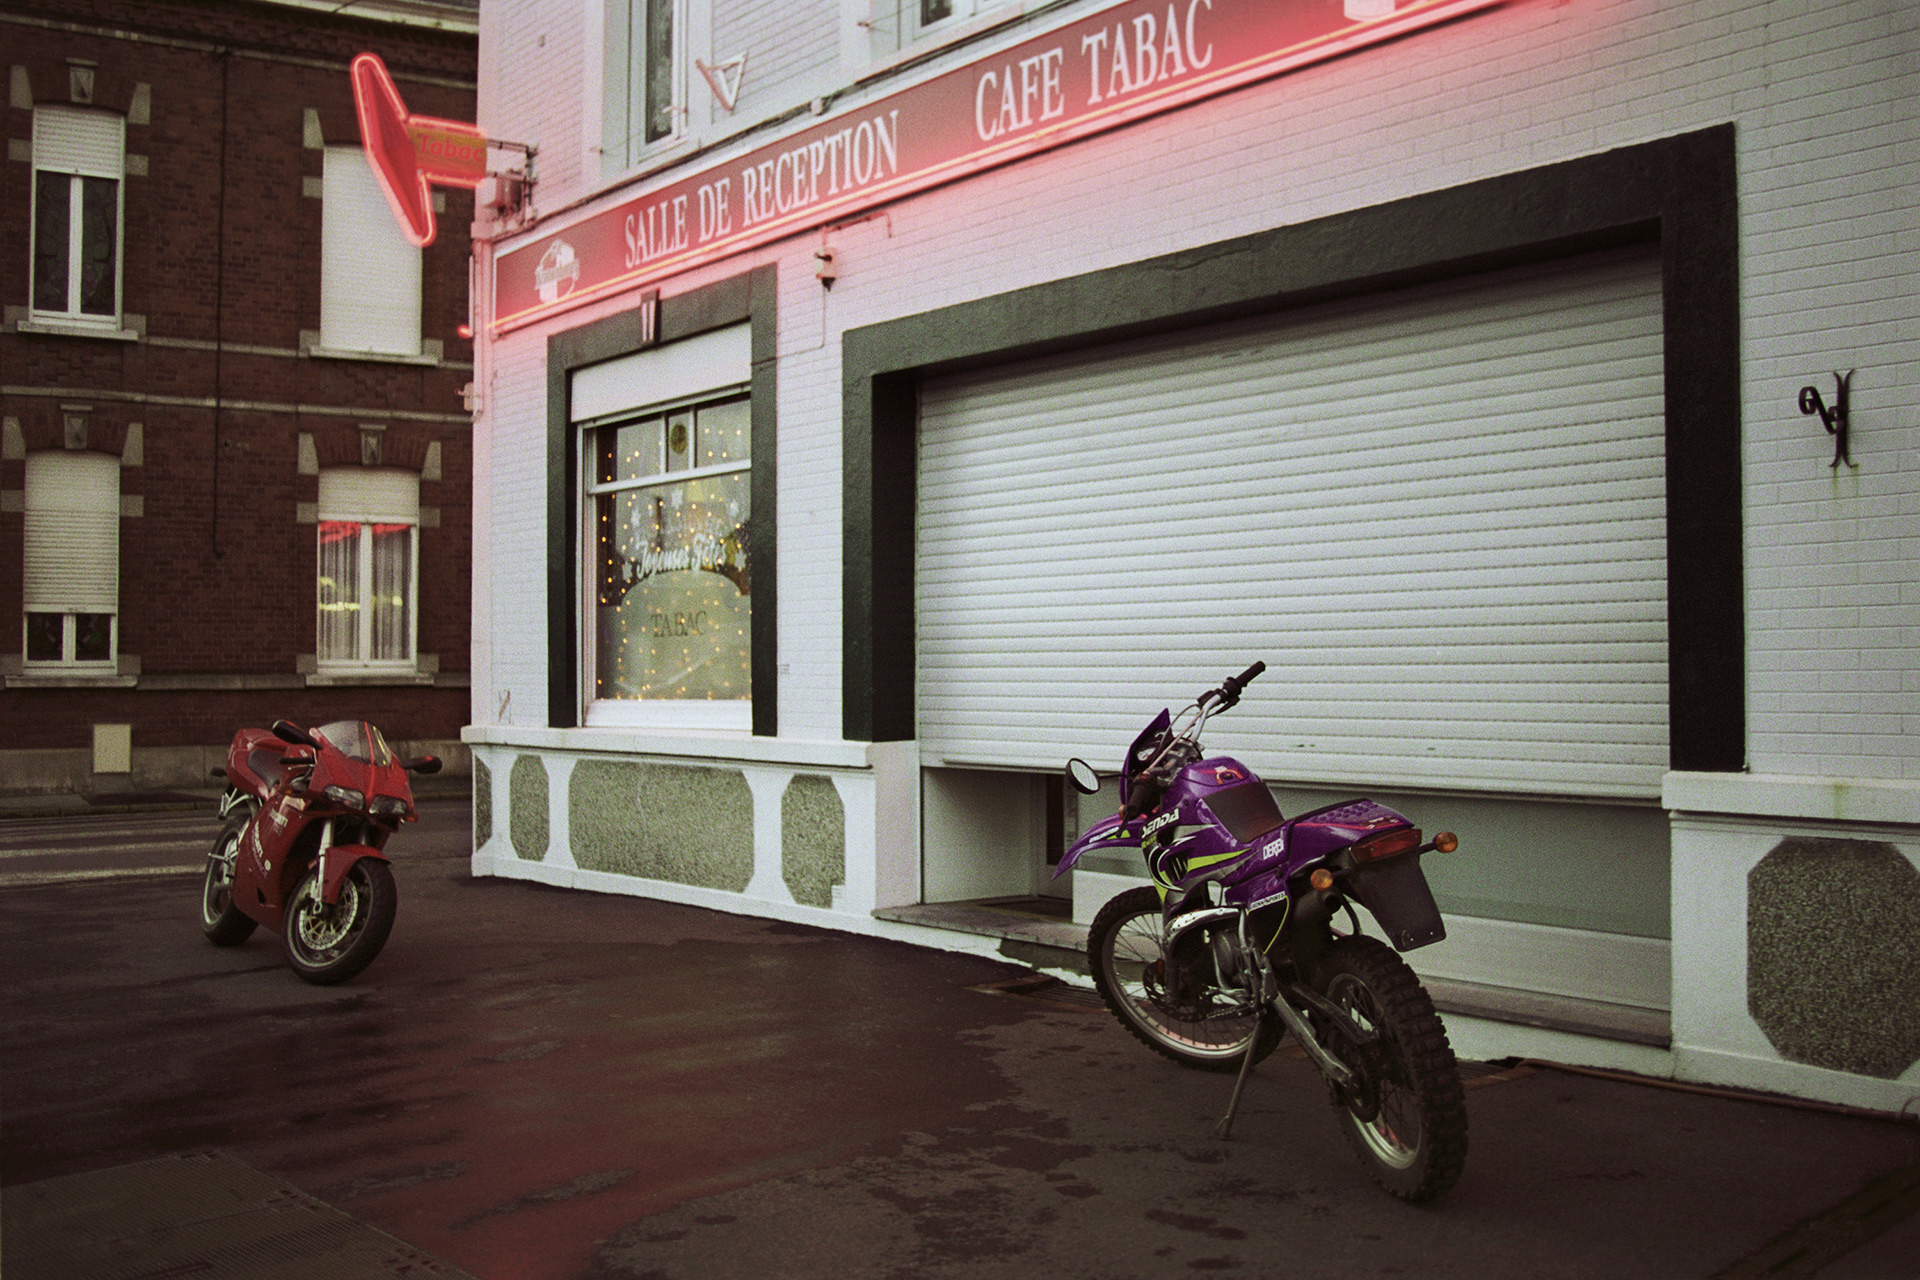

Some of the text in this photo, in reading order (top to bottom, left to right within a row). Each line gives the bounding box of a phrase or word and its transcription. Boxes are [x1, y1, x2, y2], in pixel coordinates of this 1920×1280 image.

[975, 0, 1213, 141] CAFE TABAC
[417, 133, 484, 162] Tabac
[625, 110, 899, 269] SALLE DE RECEPTION
[651, 611, 707, 637] TABAC
